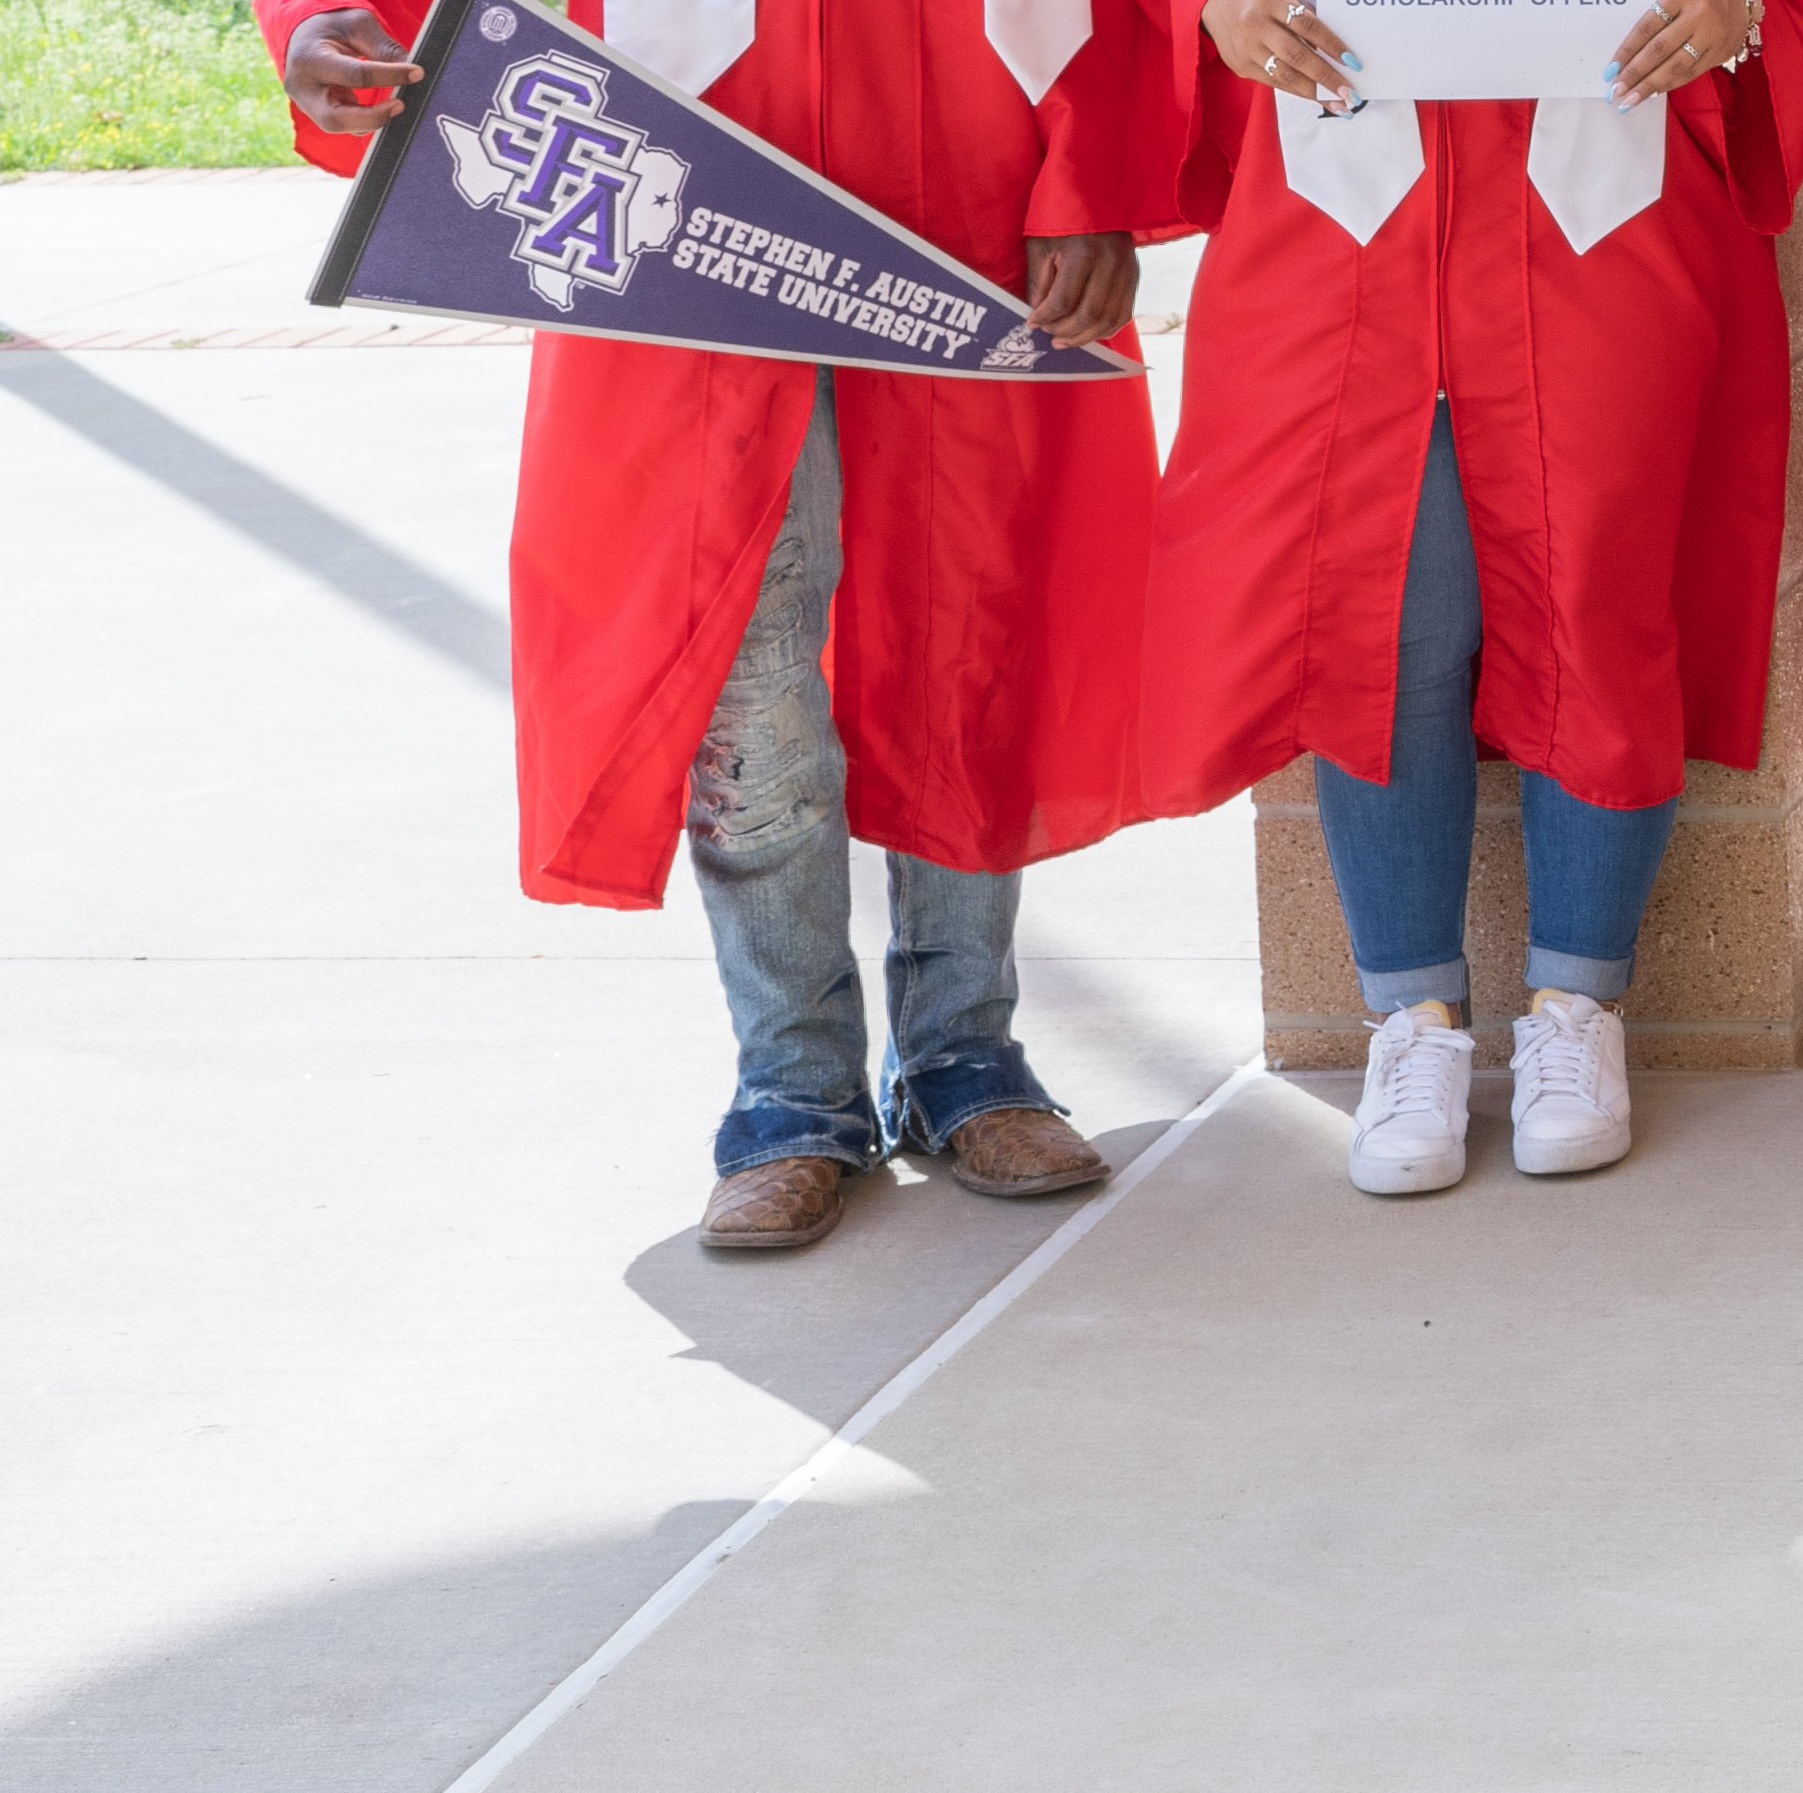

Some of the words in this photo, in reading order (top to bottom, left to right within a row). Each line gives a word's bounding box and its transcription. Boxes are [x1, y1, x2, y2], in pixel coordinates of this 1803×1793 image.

[481, 60, 643, 289] SFA
[673, 239, 777, 296] STATE
[777, 274, 971, 359] UNIVERSITY
[686, 207, 835, 281] STEPHEN
[833, 258, 861, 292] F.
[865, 271, 987, 334] AUSTIN
